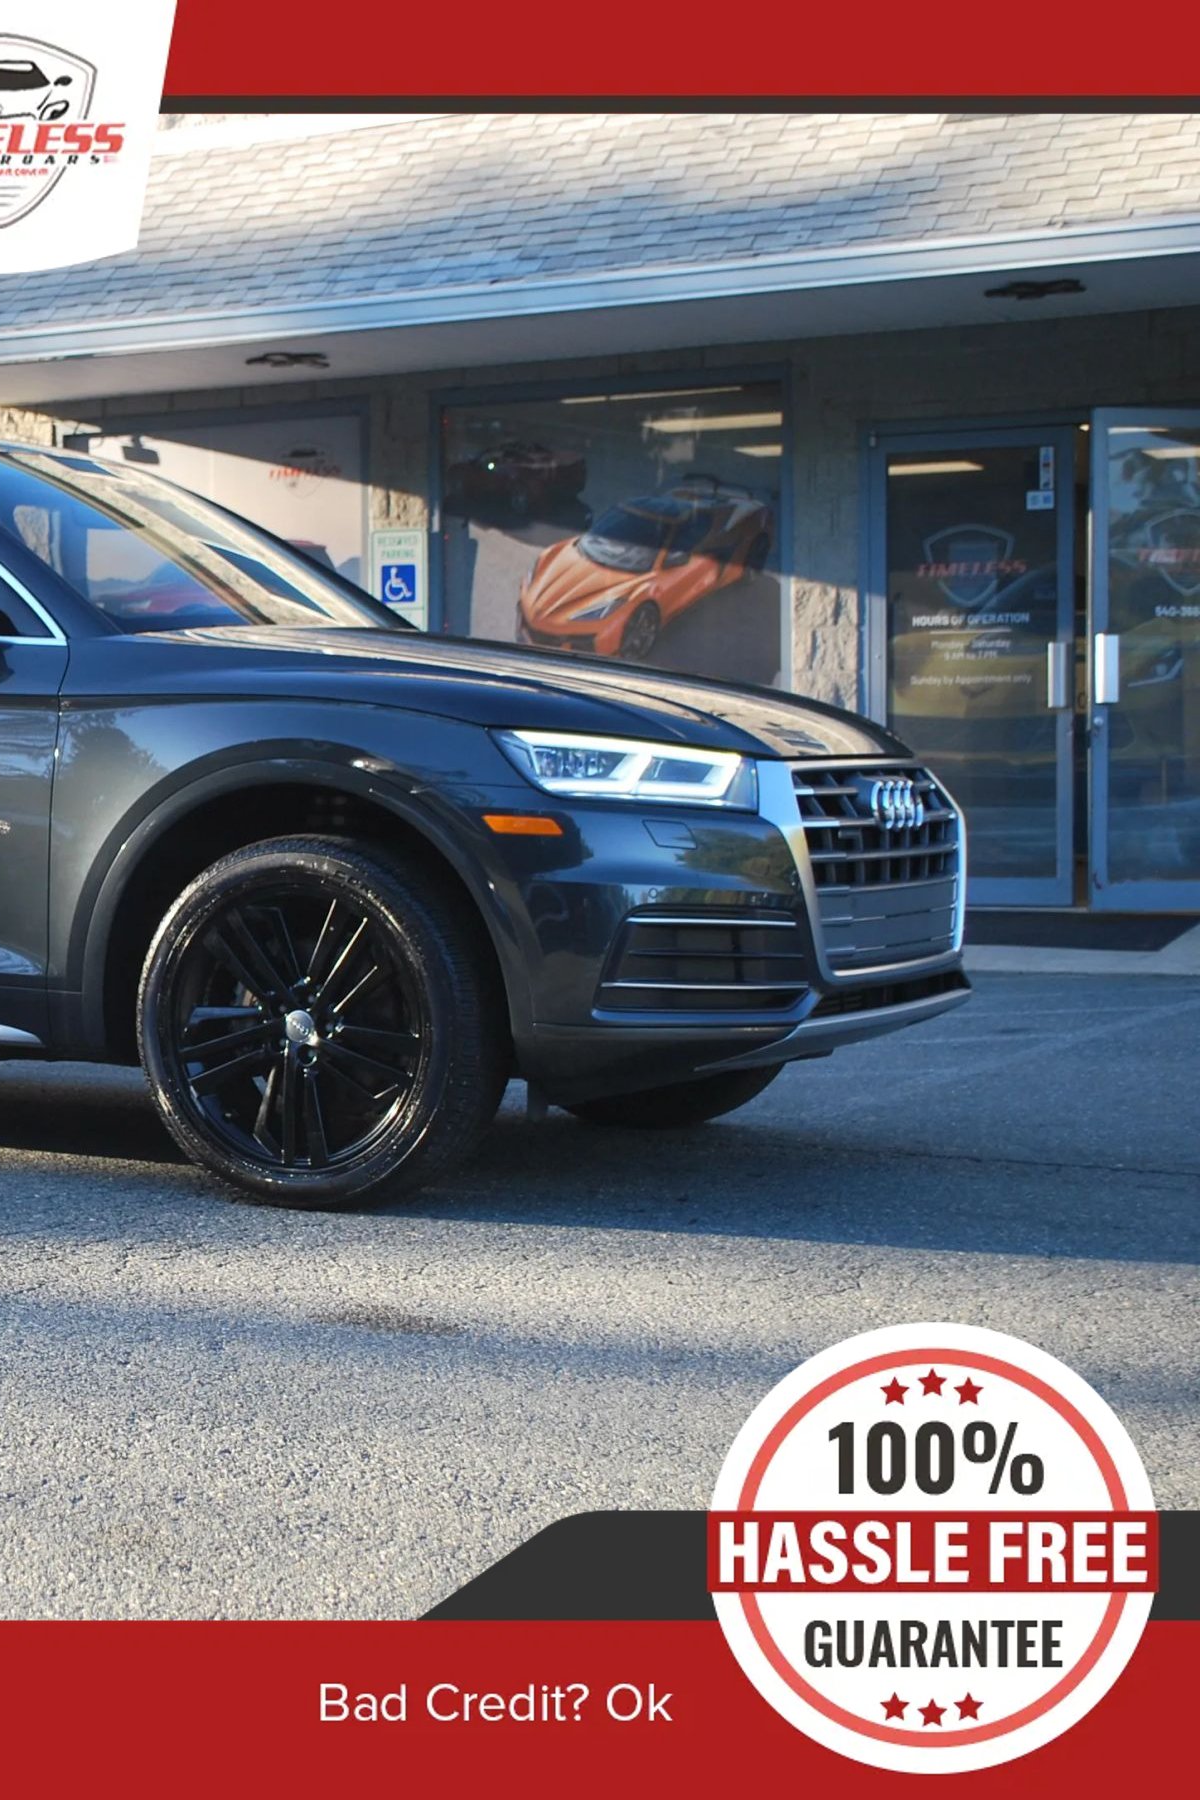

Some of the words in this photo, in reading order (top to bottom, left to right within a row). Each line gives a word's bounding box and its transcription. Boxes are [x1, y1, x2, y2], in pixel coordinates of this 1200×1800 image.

[380, 548, 415, 559] PARKING
[916, 560, 1027, 577] TIMELESS
[911, 614, 949, 627] HOURS
[950, 614, 965, 625] OF
[967, 612, 1030, 624] OPERATION
